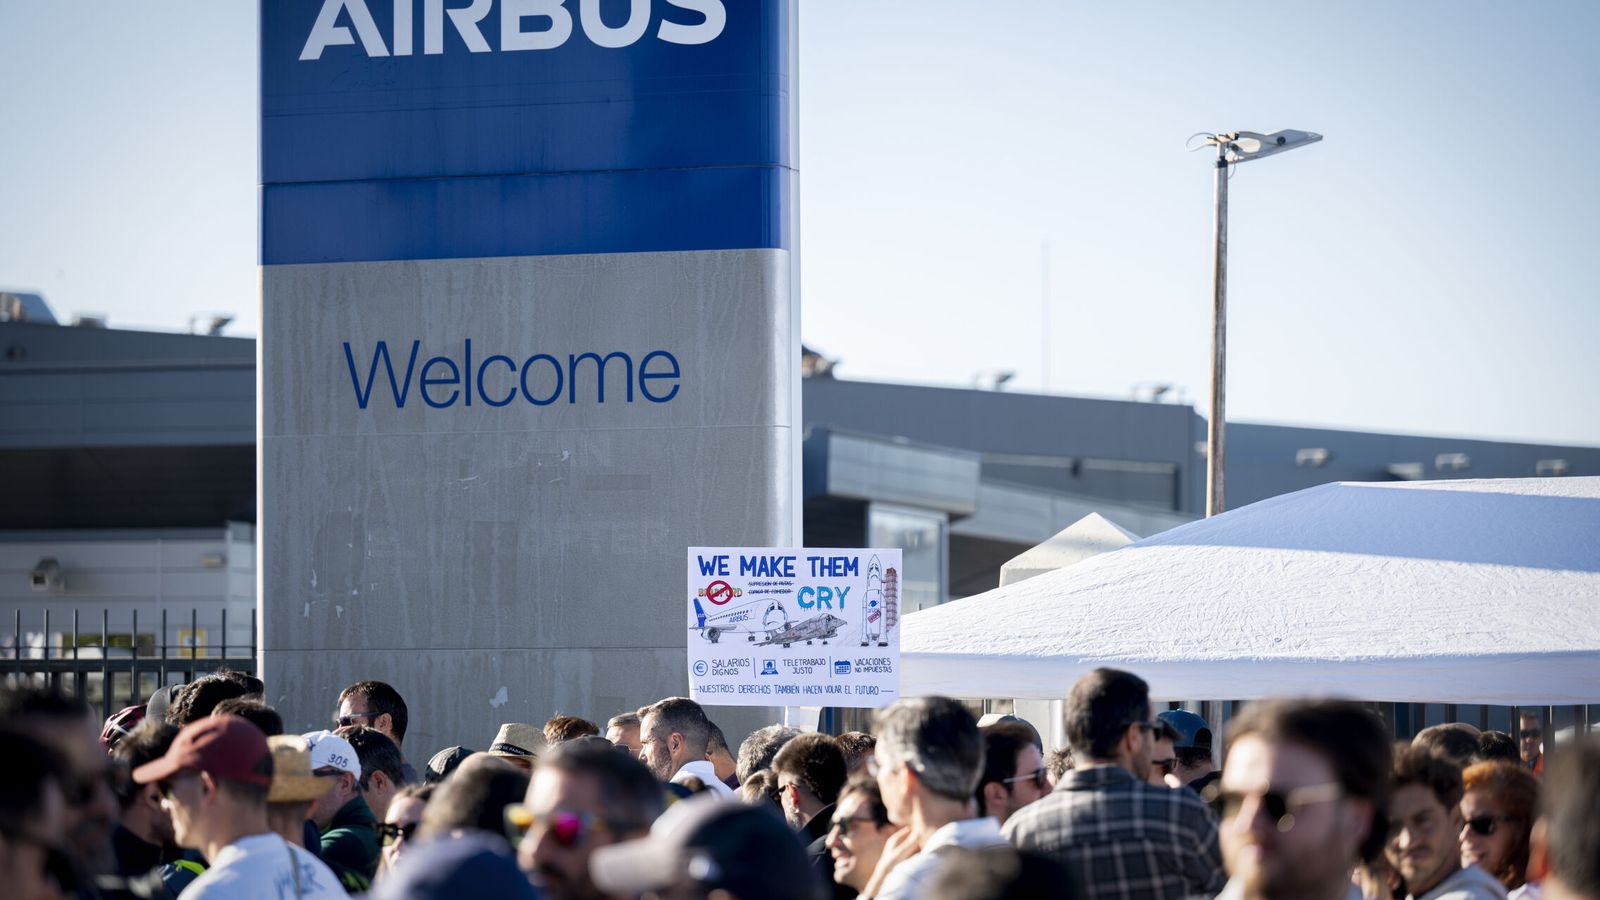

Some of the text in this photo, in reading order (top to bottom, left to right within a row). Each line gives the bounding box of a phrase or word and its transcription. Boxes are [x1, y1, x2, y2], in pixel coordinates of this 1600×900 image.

[298, 0, 728, 61] AIRBUS
[343, 338, 681, 410] Welcome
[697, 555, 859, 578] WE MAKE THEM
[797, 585, 851, 612] CRY
[728, 613, 750, 624] AIRBUS
[711, 658, 751, 668] SALARIOS
[782, 658, 826, 667] TELETRABAJO
[854, 657, 892, 666] VACACIONES
[711, 667, 739, 676] DIGNOS
[792, 666, 813, 675] JUSTO
[863, 666, 893, 674] IMPUESTAS
[699, 684, 735, 693] NUESTROS
[738, 684, 772, 695] DERECHOS
[802, 685, 823, 694] HACEN
[824, 685, 843, 694] VOLAR
[844, 685, 852, 694] EL
[855, 685, 879, 696] FUTURO
[327, 753, 349, 768] 305
